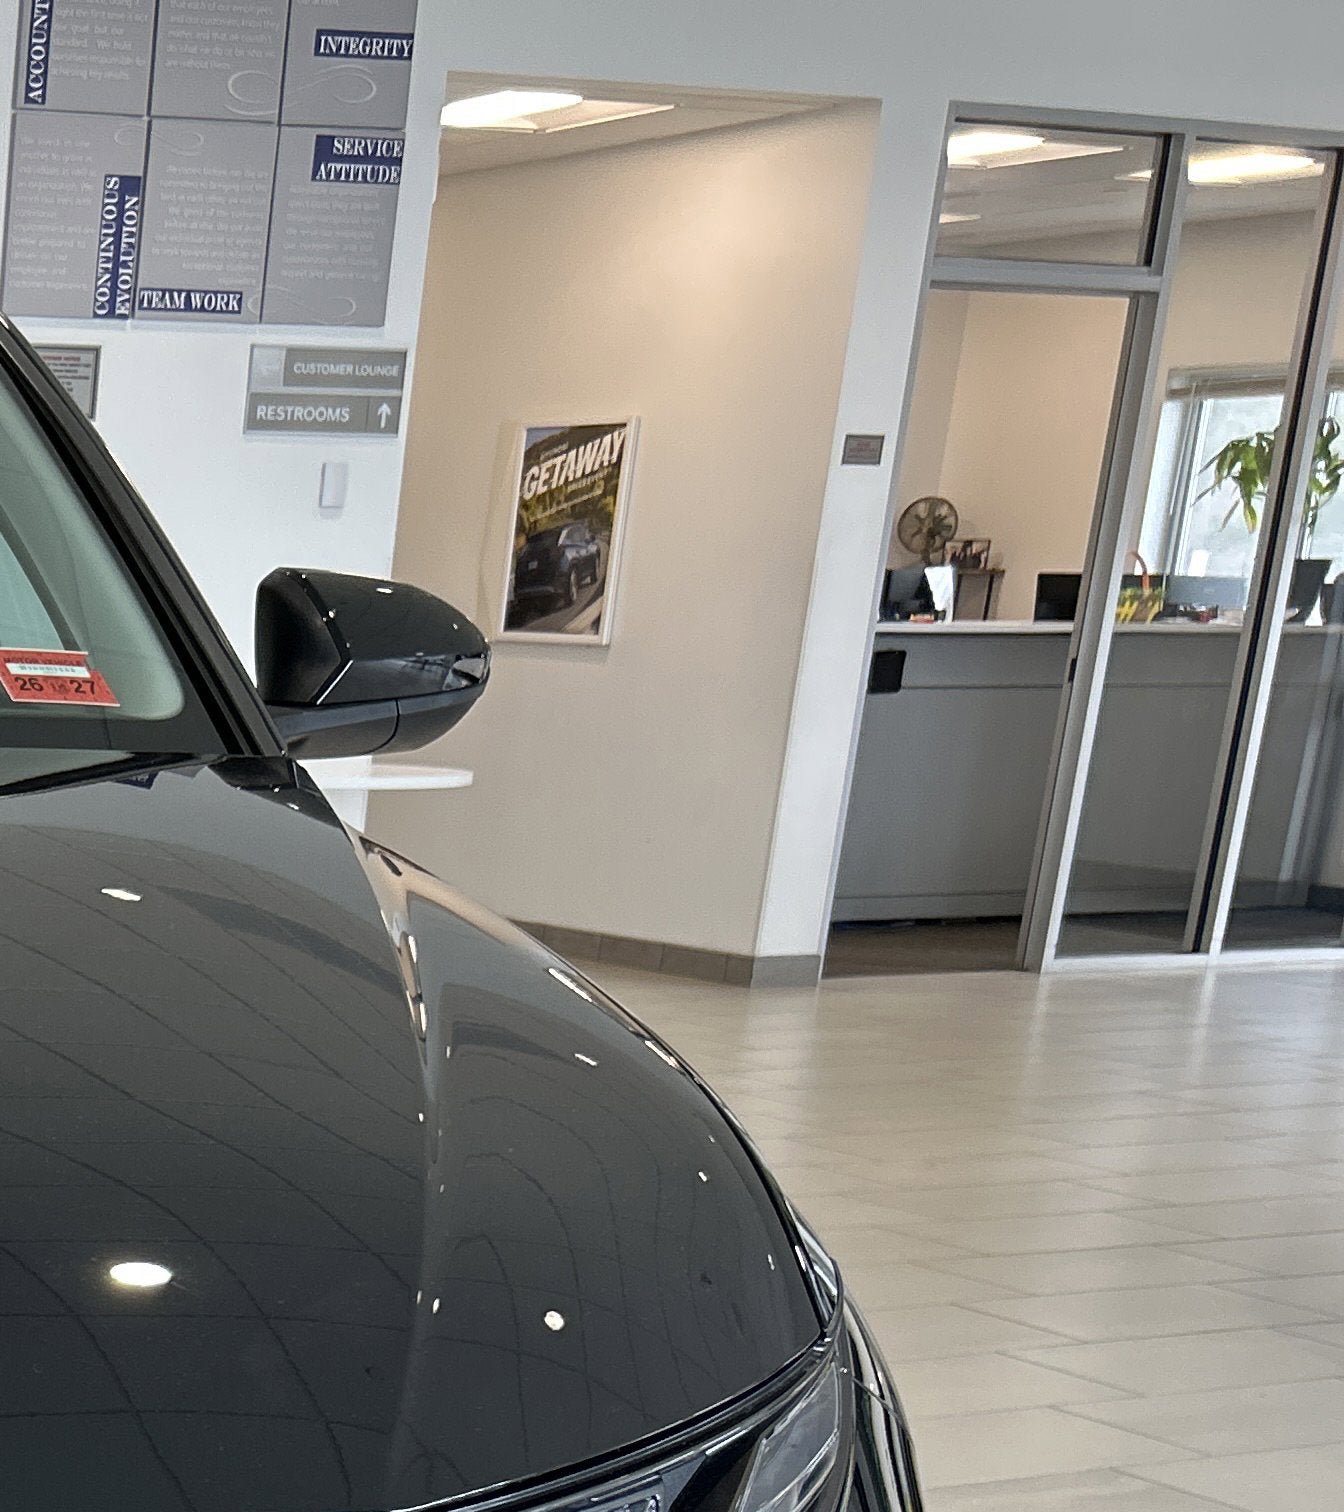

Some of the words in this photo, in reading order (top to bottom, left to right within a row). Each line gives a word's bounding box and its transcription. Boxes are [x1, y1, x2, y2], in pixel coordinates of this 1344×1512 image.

[319, 35, 413, 57] INTEGRITY
[332, 137, 403, 158] SERVICE
[315, 162, 401, 184] ATTITUDE
[94, 176, 120, 316] CONTINUOUS
[115, 195, 140, 318] EVOLUTION
[139, 290, 186, 310] TEAM
[189, 291, 241, 312] WORK
[293, 362, 353, 376] CUSTOMER
[355, 364, 400, 377] LOUNGE
[256, 404, 351, 423] RESTROOMS
[522, 428, 626, 500] GETAWAY
[14, 676, 44, 692] 26
[69, 679, 96, 695] 27
